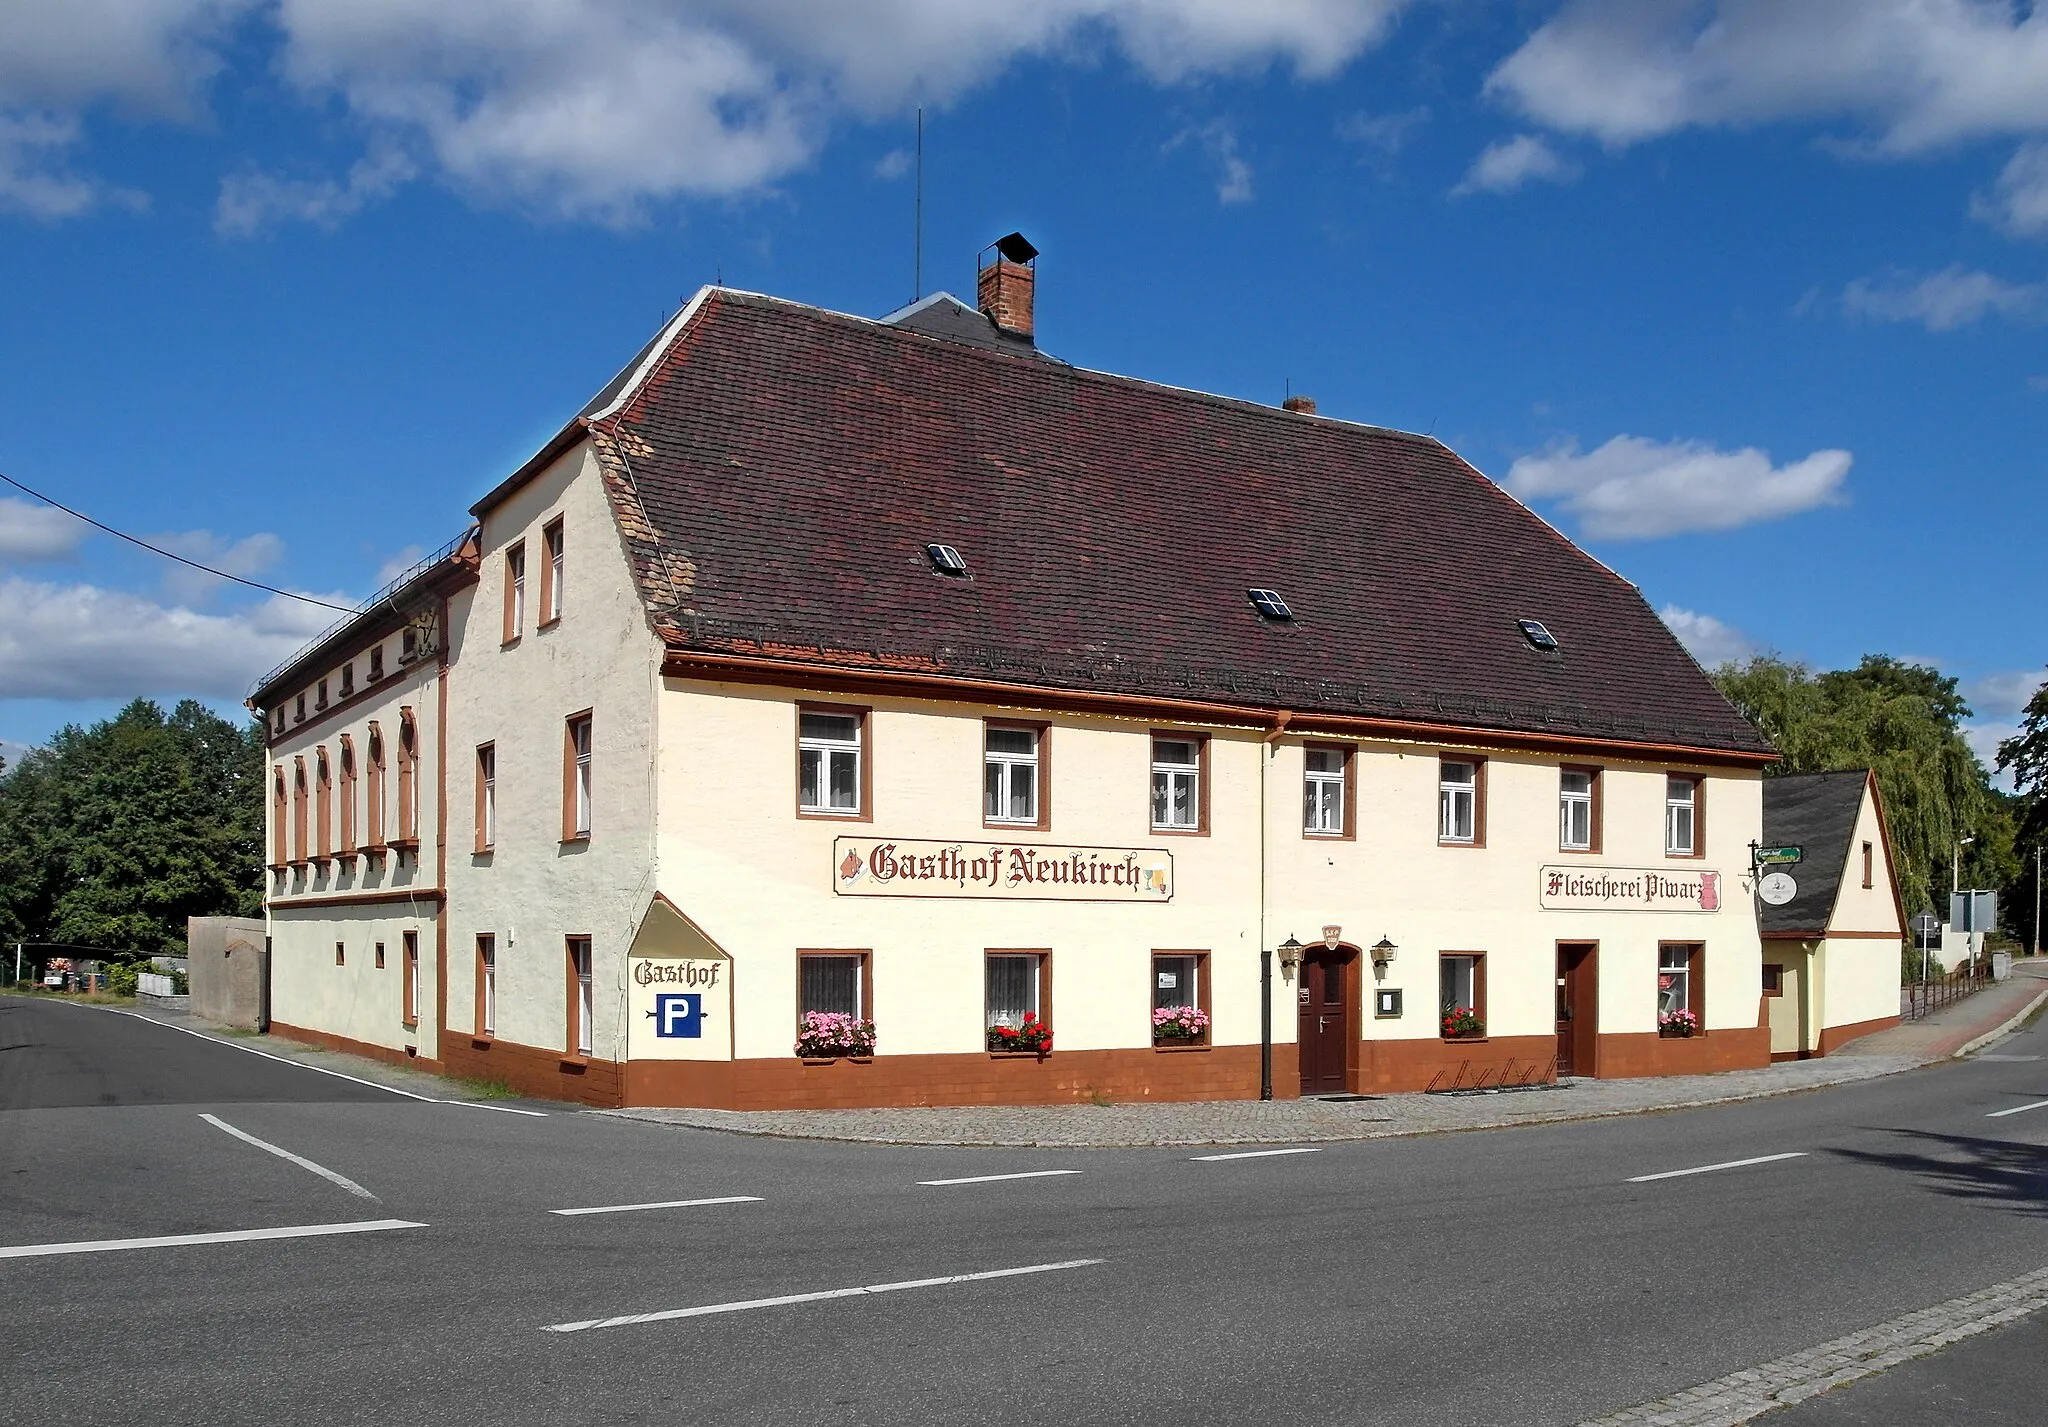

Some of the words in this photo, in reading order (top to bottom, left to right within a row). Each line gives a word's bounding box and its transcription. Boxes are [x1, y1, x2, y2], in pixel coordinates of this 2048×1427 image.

[868, 843, 1003, 888] Gasthof
[1005, 847, 1141, 892] Neukirch
[1545, 871, 1641, 901] Fleischerei
[1645, 872, 1703, 904] Piwarz
[634, 960, 721, 989] Gasthof
[664, 999, 689, 1034] P
